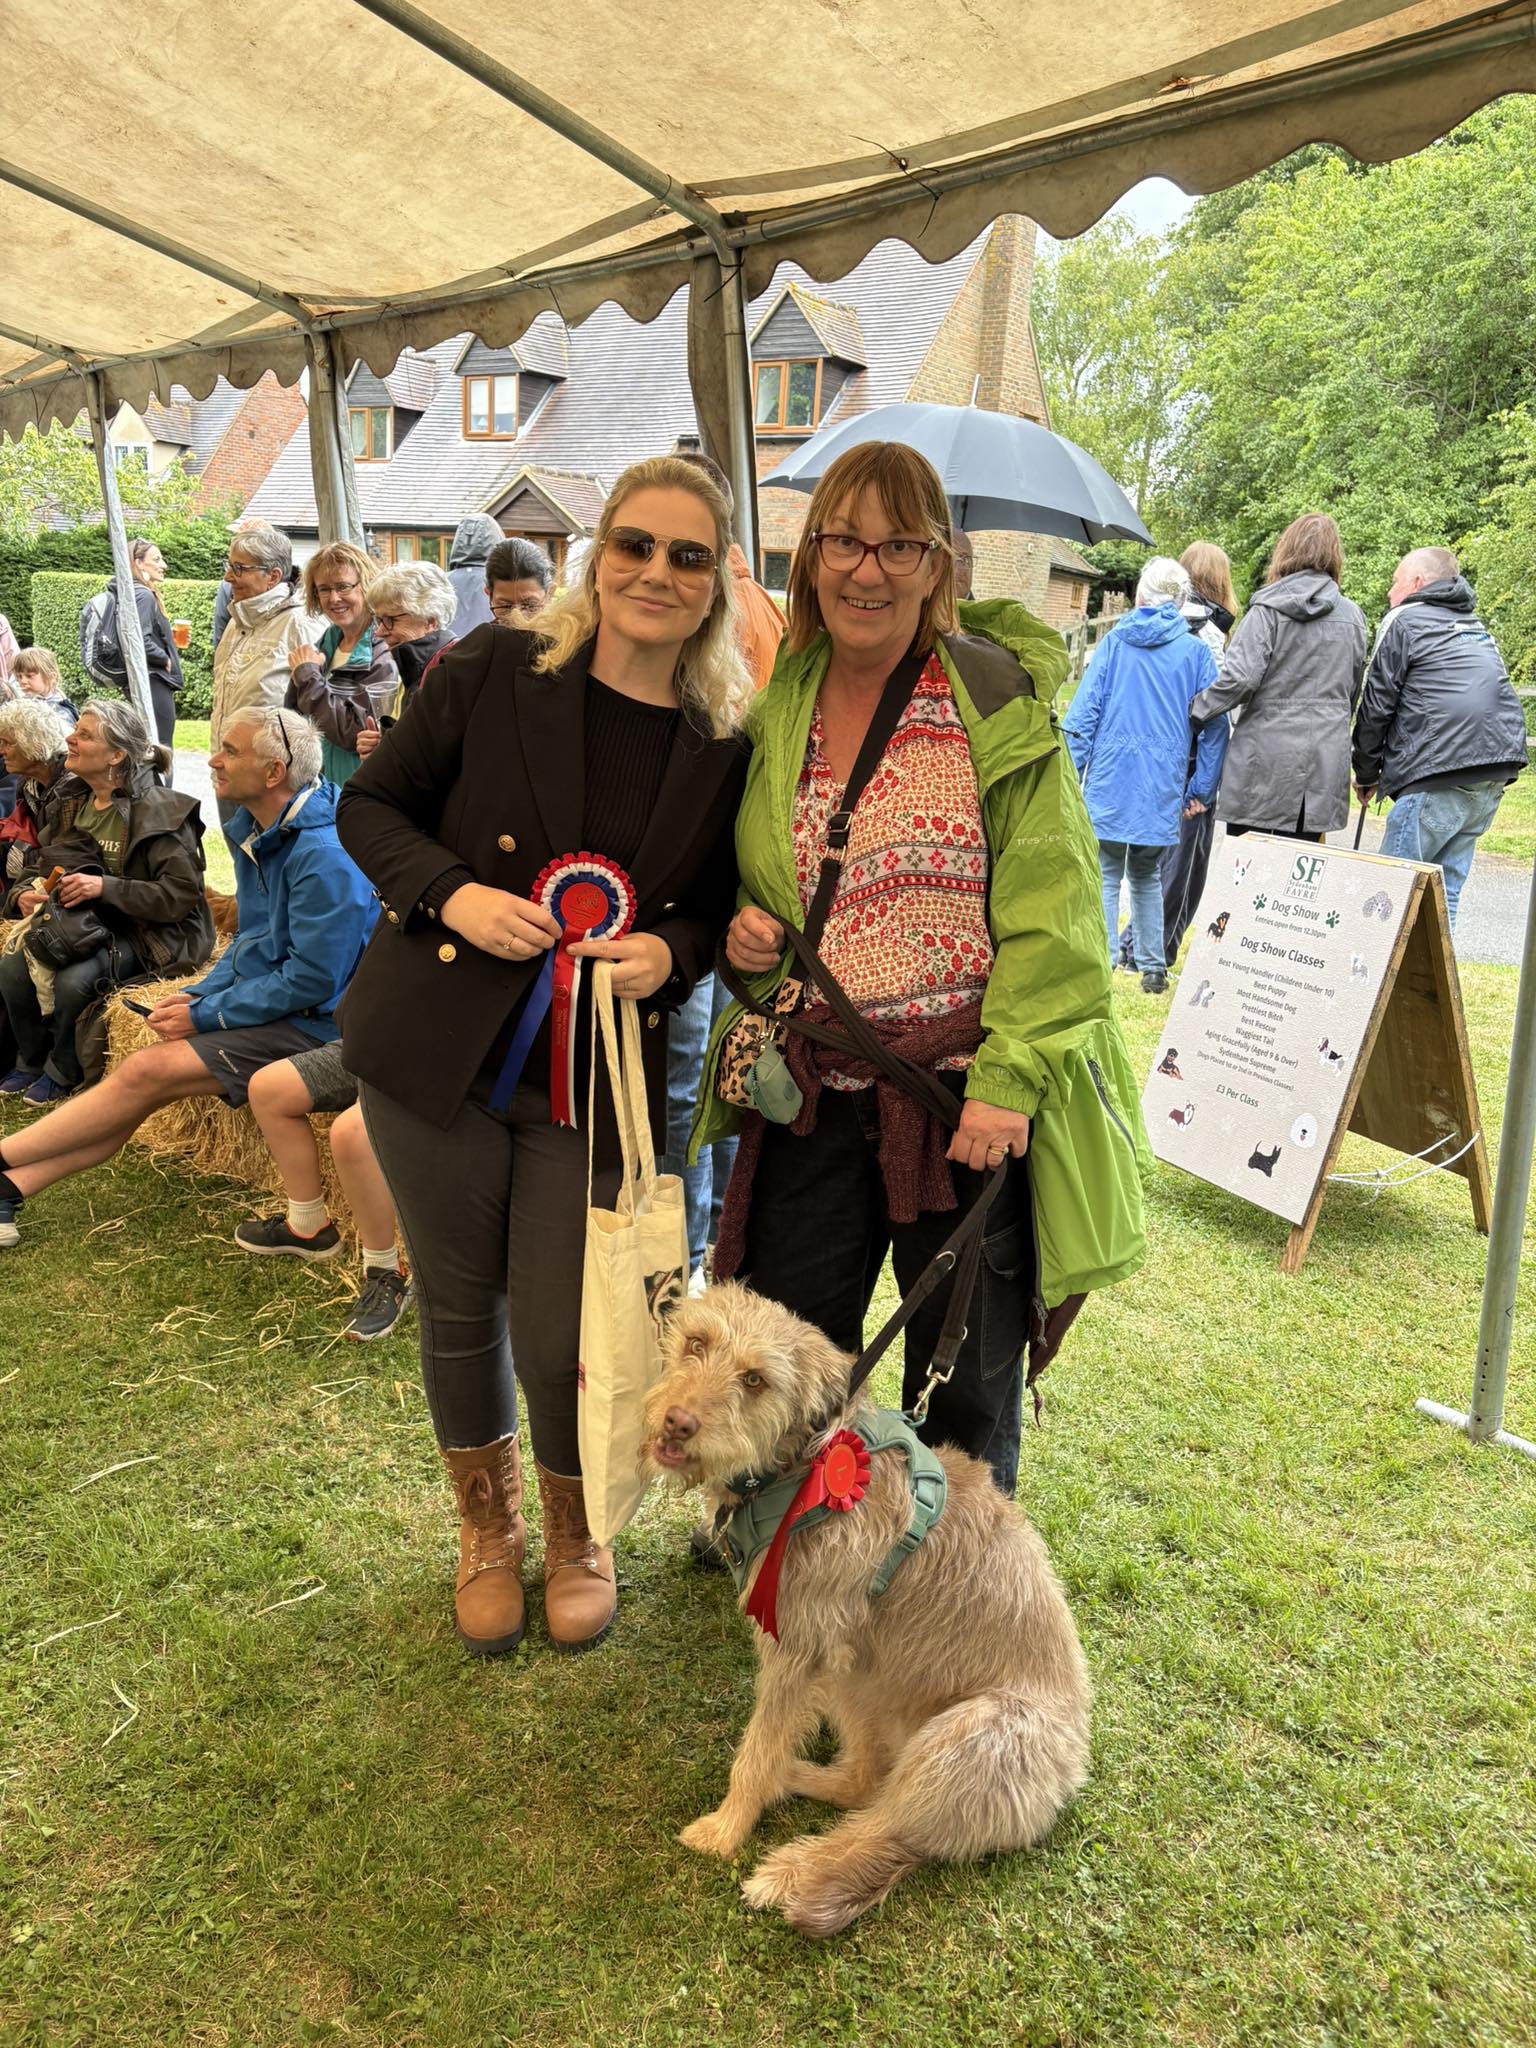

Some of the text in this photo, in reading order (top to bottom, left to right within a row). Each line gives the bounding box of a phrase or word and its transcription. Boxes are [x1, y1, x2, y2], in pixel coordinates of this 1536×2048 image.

[1292, 855, 1325, 884] SF
[1286, 886, 1317, 899] FAYRE
[1272, 900, 1320, 921] Dog Show
[1254, 915, 1327, 939] Entries open from 12.30pm
[1240, 936, 1326, 969] Dog Show Classes
[1218, 957, 1335, 999] Best Young Handler (Children Under 10)
[1253, 980, 1287, 999] Best Puppy
[1236, 988, 1298, 1015] Most Handsome Dog
[1241, 1002, 1284, 1023] Prettiest Bitch
[1235, 1026, 1275, 1047] Waggiest Tail
[1241, 1015, 1277, 1034] Best Rescue
[1204, 1029, 1299, 1069] Aging Gracefully (Aged 9 & Over)
[1218, 1046, 1277, 1074] Sydenham Supreme
[1215, 1083, 1259, 1108] £3 Per Class
